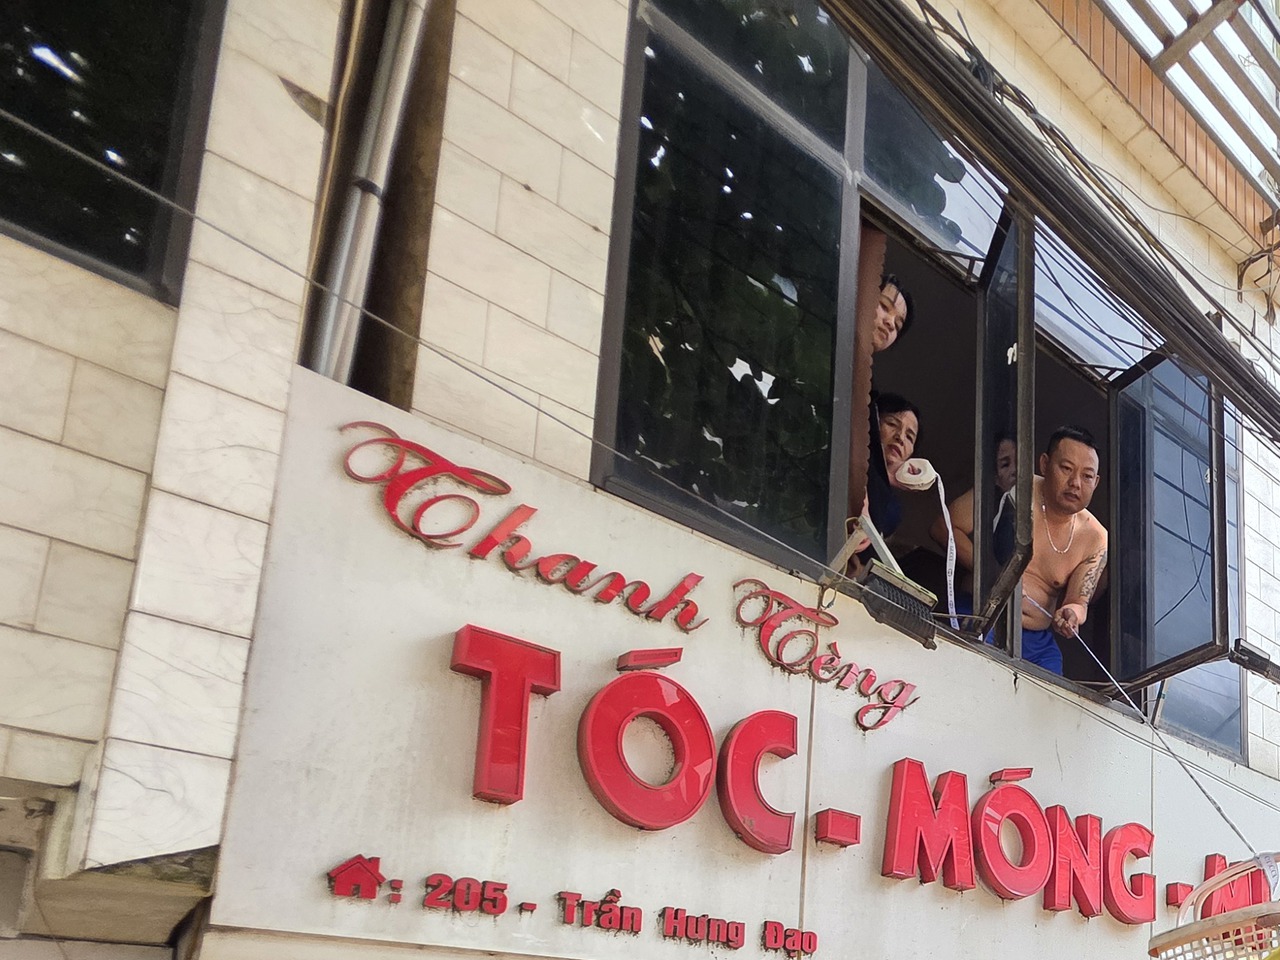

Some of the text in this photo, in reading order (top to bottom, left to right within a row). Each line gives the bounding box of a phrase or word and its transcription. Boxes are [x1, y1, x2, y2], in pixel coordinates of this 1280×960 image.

[339, 420, 709, 633] Thanh
[450, 623, 798, 855] TÓC
[881, 757, 1157, 924] MÓNG
[422, 872, 509, 916] 205
[557, 888, 643, 934] Trần
[662, 906, 747, 951] Hưng
[761, 920, 819, 959] Đạo
